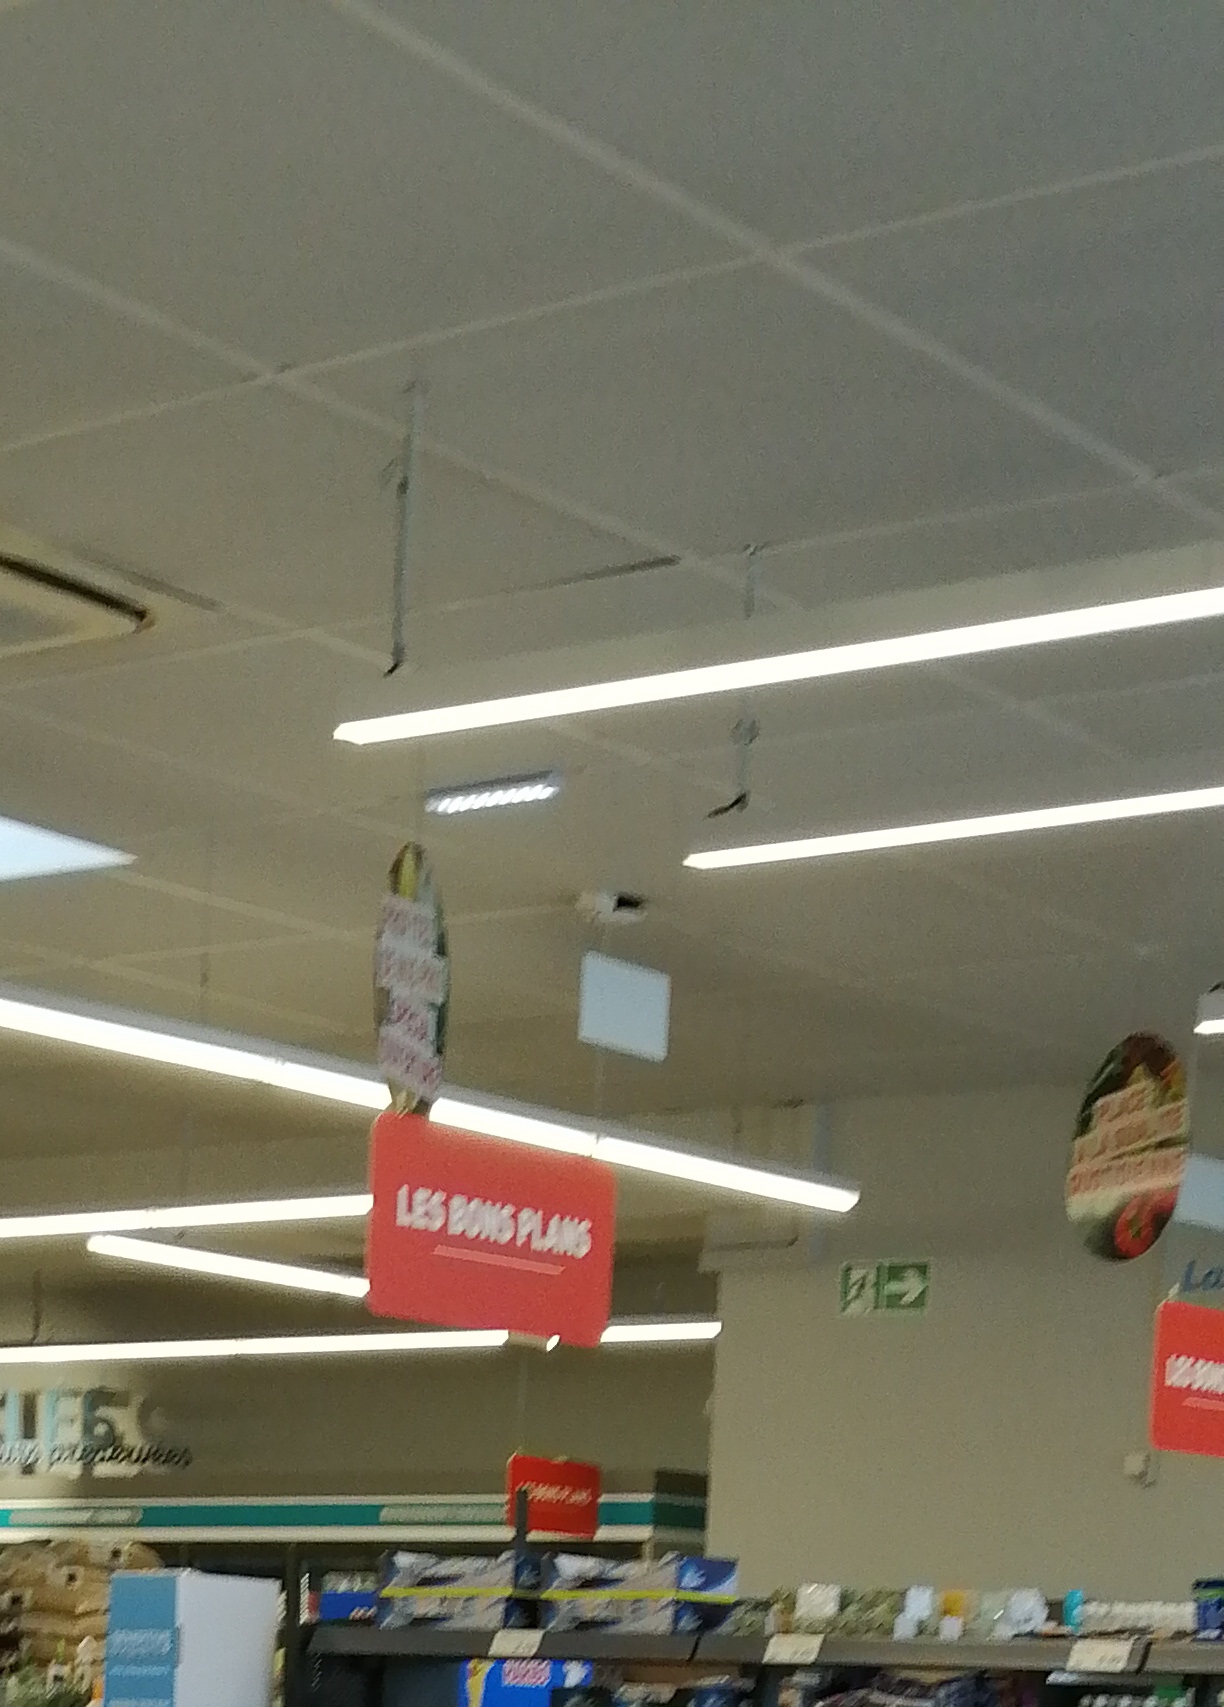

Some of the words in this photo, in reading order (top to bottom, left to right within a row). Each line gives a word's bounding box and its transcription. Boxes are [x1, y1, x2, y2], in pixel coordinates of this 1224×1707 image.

[396, 1184, 446, 1232] LES
[446, 1194, 515, 1244] BONS
[516, 1207, 592, 1258] PLANS
